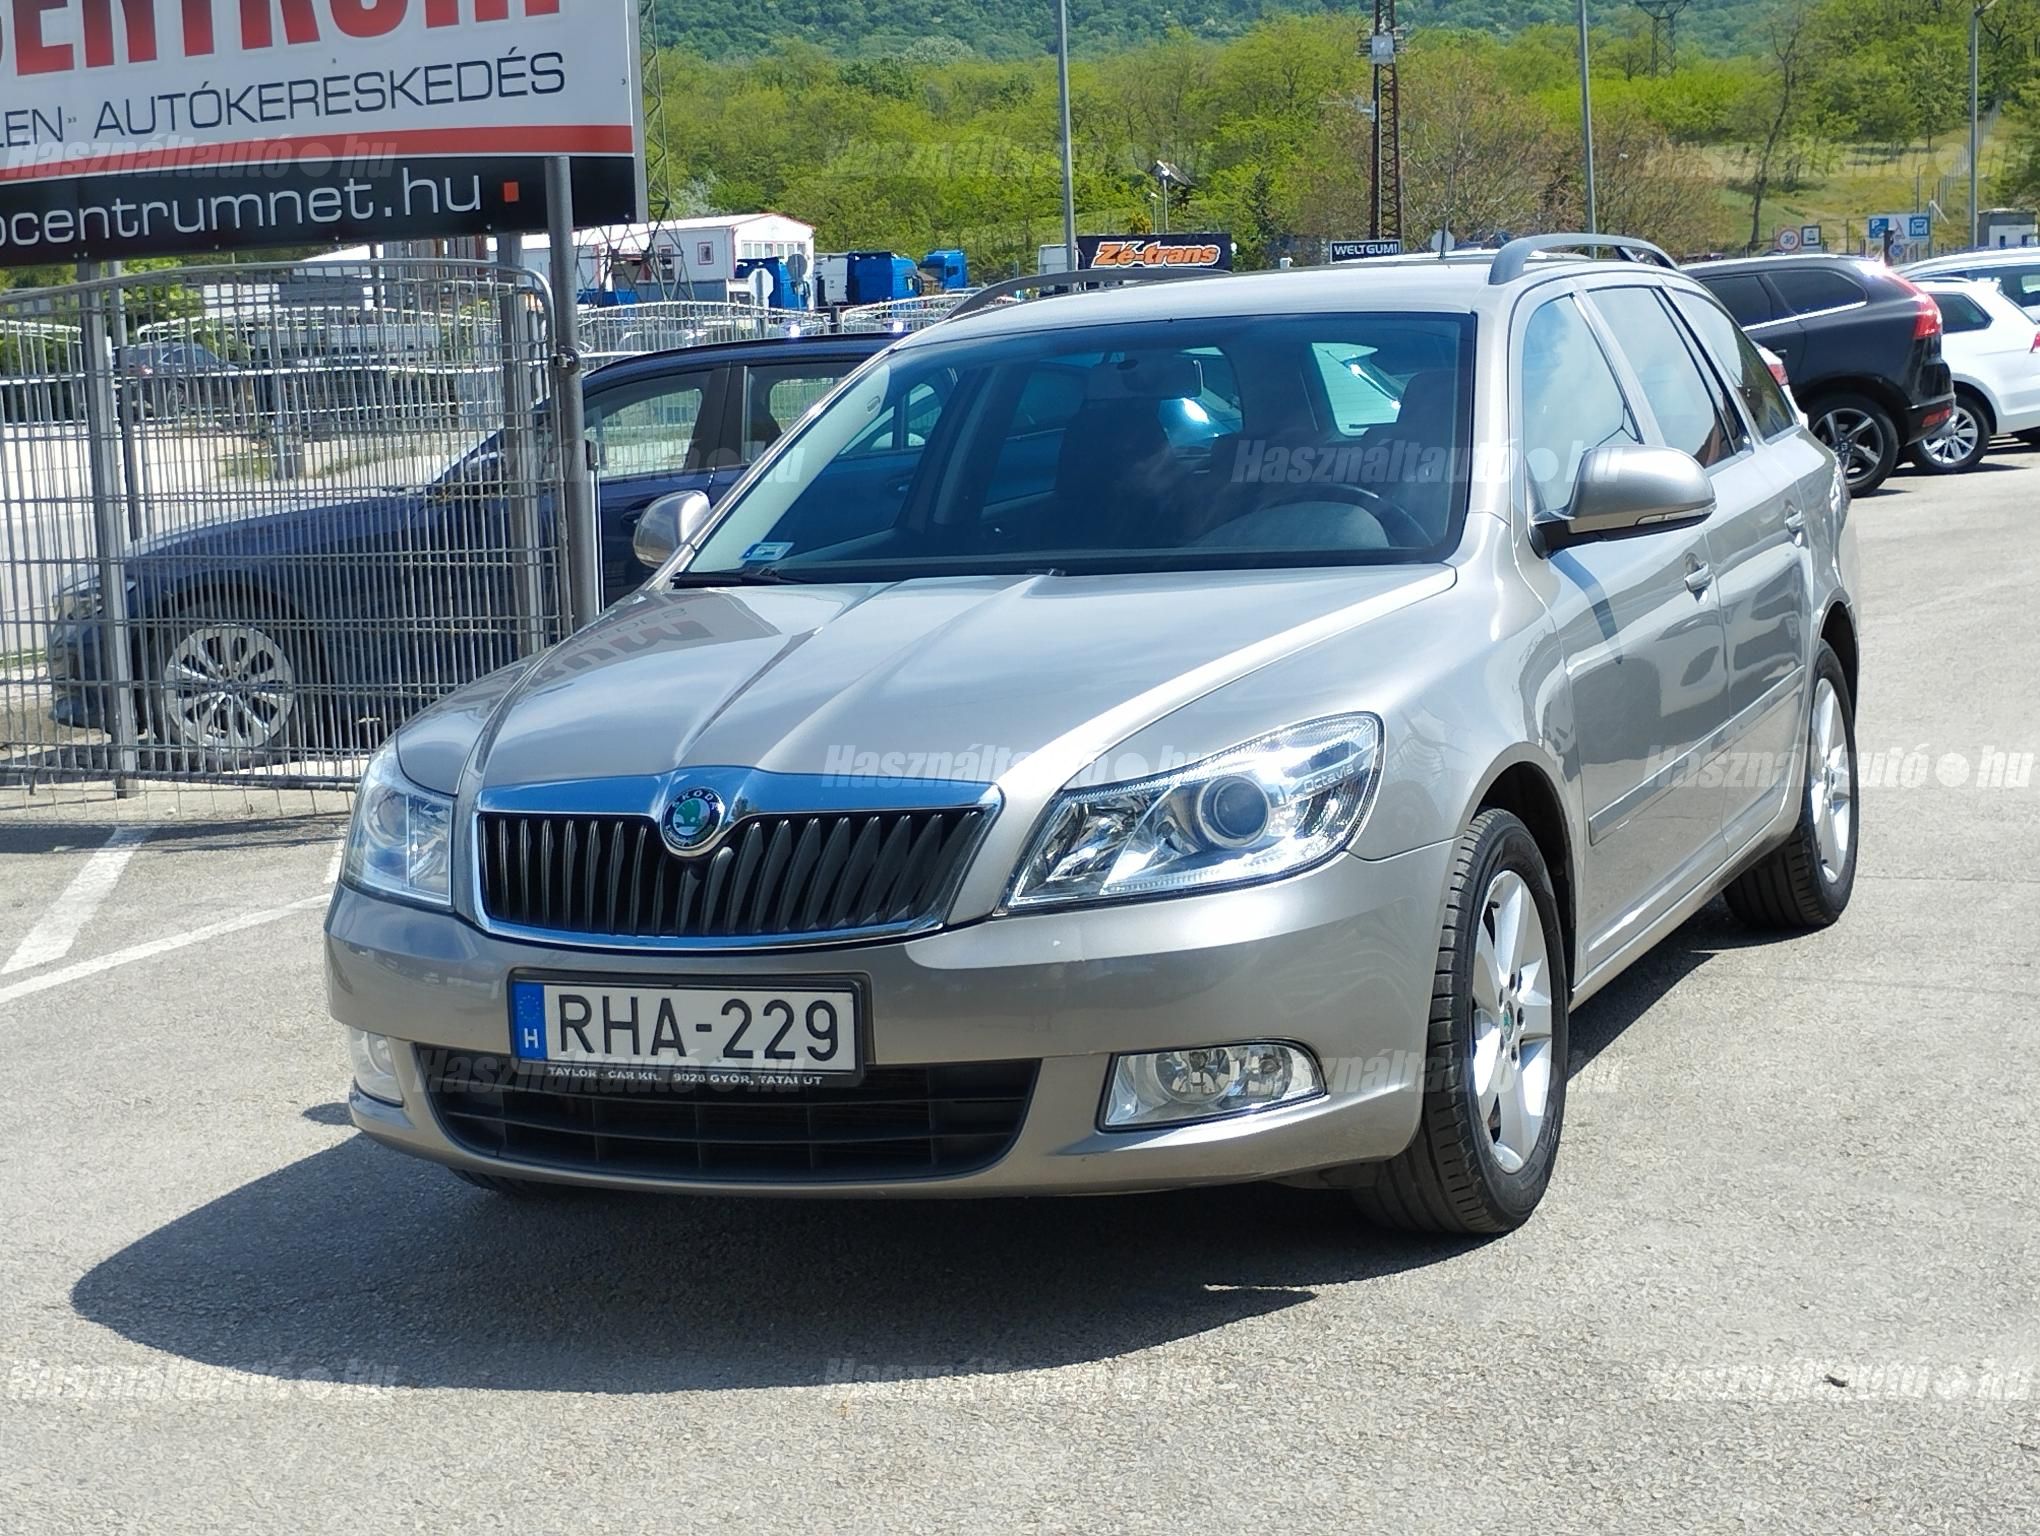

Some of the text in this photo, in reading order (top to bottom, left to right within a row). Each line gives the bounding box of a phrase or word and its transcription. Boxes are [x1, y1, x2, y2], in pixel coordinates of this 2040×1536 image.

[0, 47, 566, 147] EN AUTÓKERESKEDÉS
[0, 168, 481, 247] centrumnet.hu
[1091, 241, 1219, 267] Zé-trans
[1304, 764, 1354, 792] Octavia
[523, 1028, 540, 1049] H
[558, 993, 839, 1062] RHA-229
